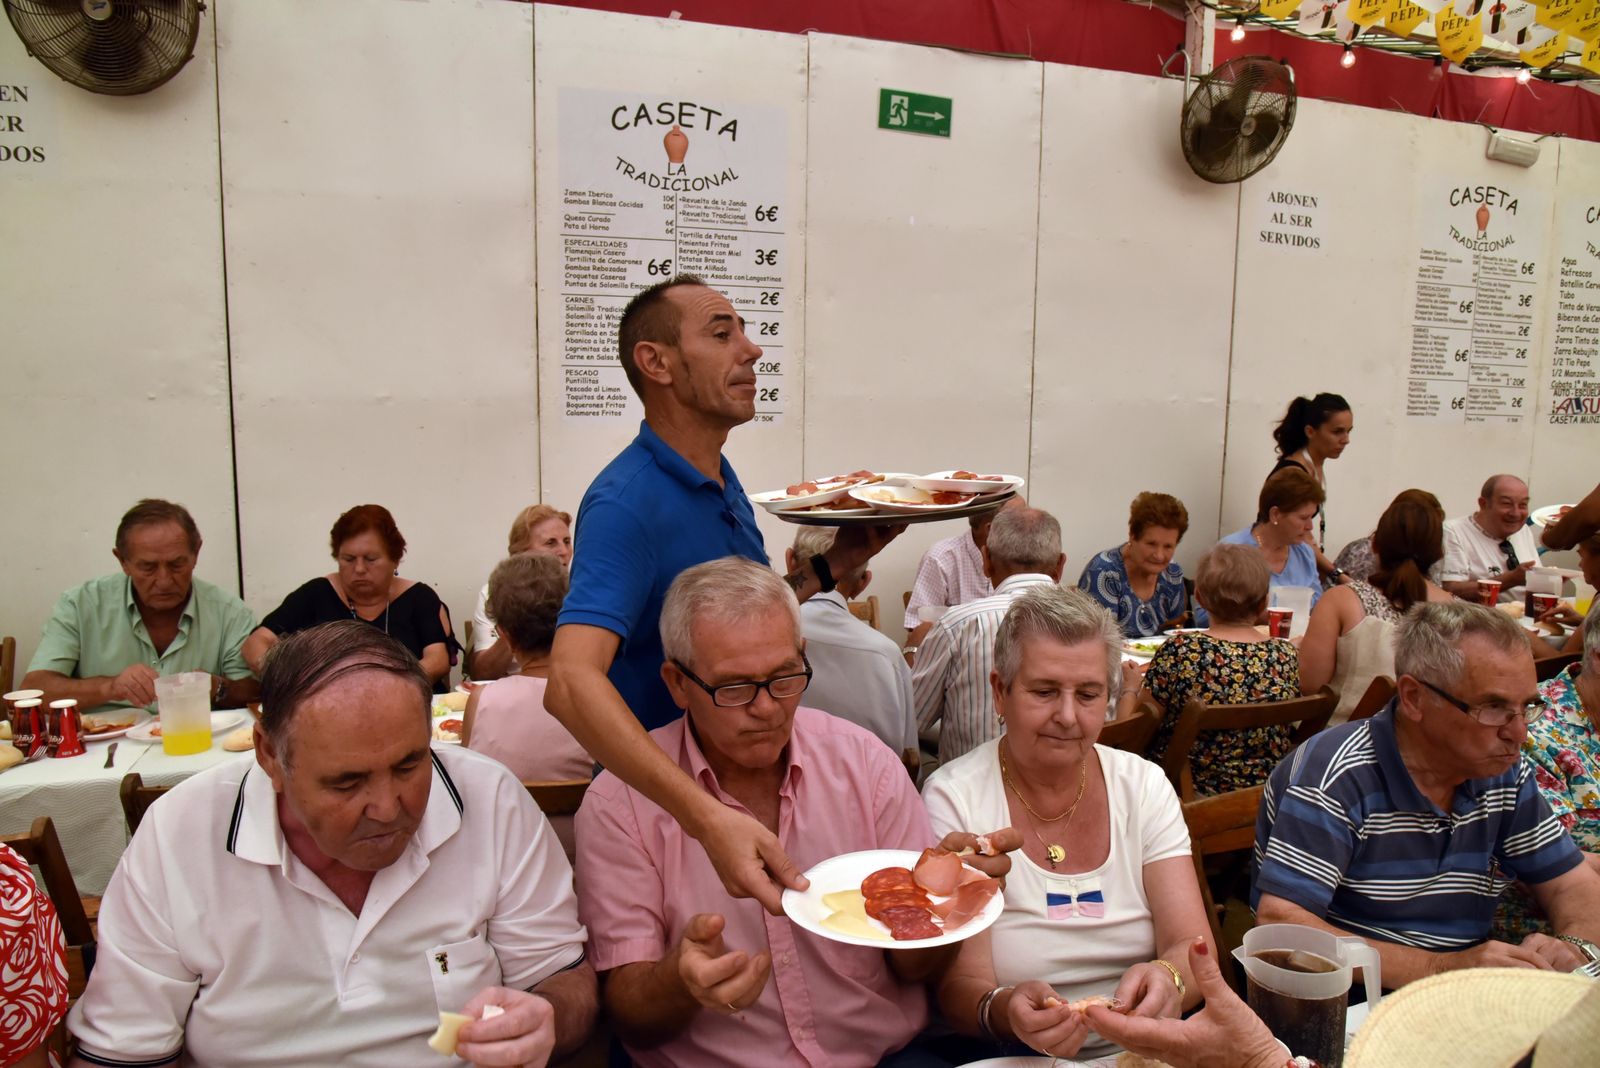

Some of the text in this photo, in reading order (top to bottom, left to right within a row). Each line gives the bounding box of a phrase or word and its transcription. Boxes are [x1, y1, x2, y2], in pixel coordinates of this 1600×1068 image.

[1390, 6, 1424, 23] PEPE
[1441, 18, 1470, 31] PEPE
[611, 102, 738, 142] CASETA
[616, 156, 739, 192] TRADICIONAL
[667, 162, 687, 176] LA
[588, 190, 613, 198] Iberico
[1267, 191, 1318, 208] ABONEN
[1450, 186, 1518, 215] CASETA
[755, 205, 778, 222] 6€
[1270, 212, 1312, 228] AL SER
[1260, 230, 1320, 249] SERVIDOS
[1449, 225, 1515, 252] TRADICIONAL
[1477, 230, 1487, 240] LA
[564, 239, 628, 248] ESPECIALIDADES
[564, 247, 601, 256] Flamenquin
[679, 248, 714, 256] Berenjenas
[755, 249, 778, 266] 3€
[1562, 256, 1577, 267] Agua
[648, 258, 672, 276] 6€
[1521, 262, 1535, 275] 6€
[1560, 267, 1592, 278] Refrescos
[564, 272, 598, 280] Croquetas
[746, 275, 782, 283] Langostinos
[600, 281, 628, 289] Solomillo
[1560, 278, 1584, 288] Botellin
[760, 292, 780, 306] 2€
[1560, 290, 1575, 299] Tubo
[1460, 300, 1473, 313] 6€
[1518, 295, 1532, 307] 3€
[1559, 302, 1575, 310] Tinto
[1576, 303, 1584, 311] de
[1557, 313, 1581, 321] Biberon
[1582, 314, 1590, 322] de
[760, 322, 779, 336] 2€
[1518, 326, 1530, 336] 2€
[1556, 324, 1599, 334] Jarra Cerveza
[1555, 336, 1599, 345] Jarra Tinto de
[1454, 349, 1469, 362] 6€
[1516, 348, 1527, 359] 2€
[1554, 347, 1598, 358] Jarra Rebujito
[1553, 358, 1590, 368] 1/2 Tio Pepe
[1552, 369, 1562, 377] 1/2
[1551, 380, 1572, 388] Cubata
[760, 388, 778, 402] 2€
[1553, 388, 1570, 396] AUTO
[1451, 397, 1465, 410] 6€
[1511, 397, 1523, 408] 2€
[1550, 416, 1578, 424] CASETA
